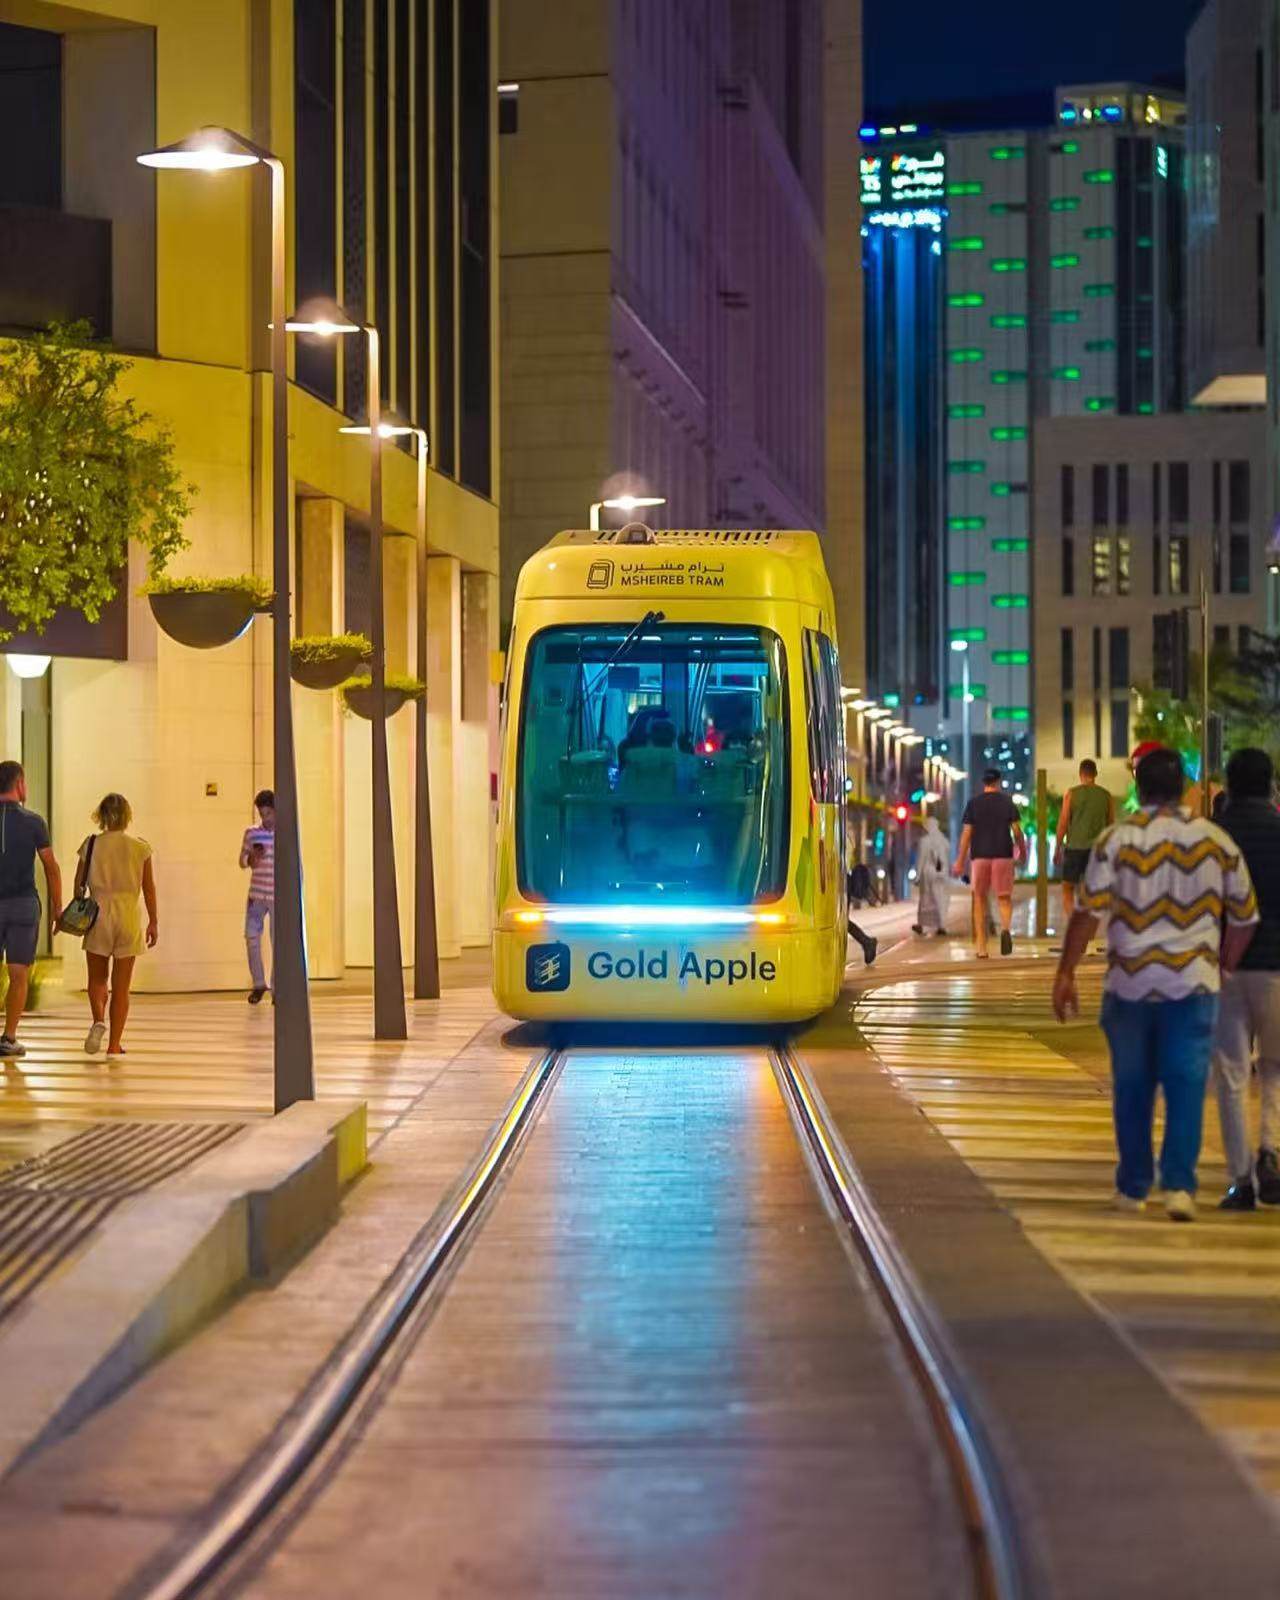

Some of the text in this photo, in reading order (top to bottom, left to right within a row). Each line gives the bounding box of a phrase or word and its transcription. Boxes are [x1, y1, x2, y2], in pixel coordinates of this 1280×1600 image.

[621, 575, 724, 587] MSHEIREB TRAM
[587, 950, 776, 985] Gold Apple
